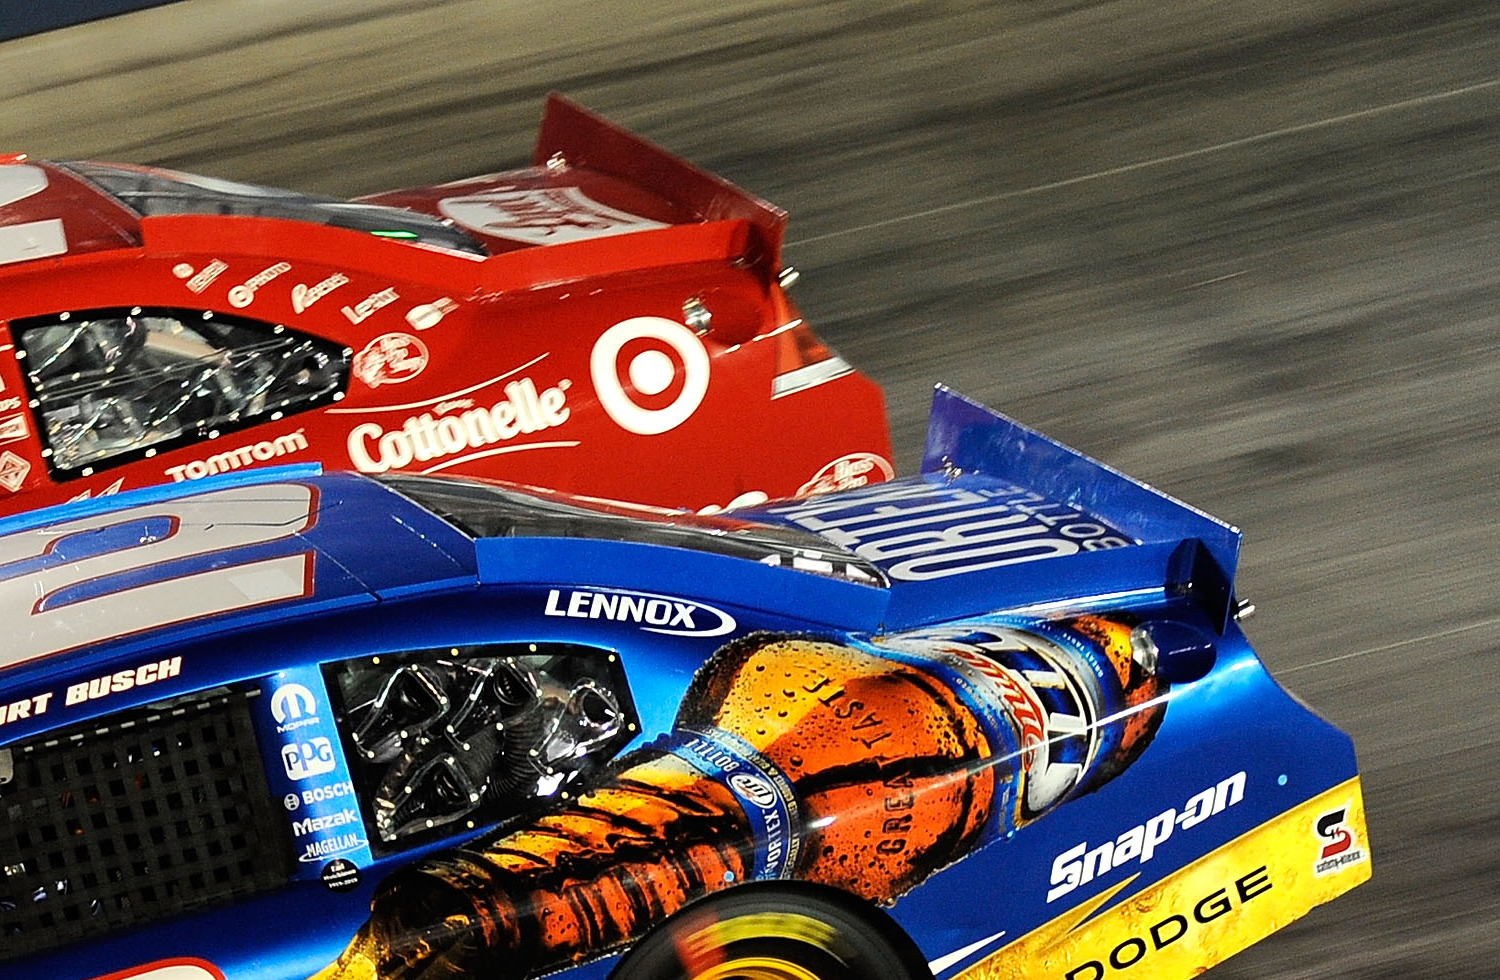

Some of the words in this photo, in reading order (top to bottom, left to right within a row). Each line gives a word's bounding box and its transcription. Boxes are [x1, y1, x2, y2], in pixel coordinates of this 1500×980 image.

[347, 378, 570, 472] Cottonelle
[544, 589, 697, 628] LENNOX
[65, 656, 184, 707] BUSCH
[276, 716, 320, 734] MOPAR
[285, 740, 332, 772] PPG
[302, 780, 355, 806] BOSCH
[876, 754, 914, 855] GREAT
[292, 808, 359, 837] Mazak
[764, 808, 783, 874] VORTEX
[1046, 770, 1247, 903] Snap-on
[305, 832, 359, 859] MAGELLAN
